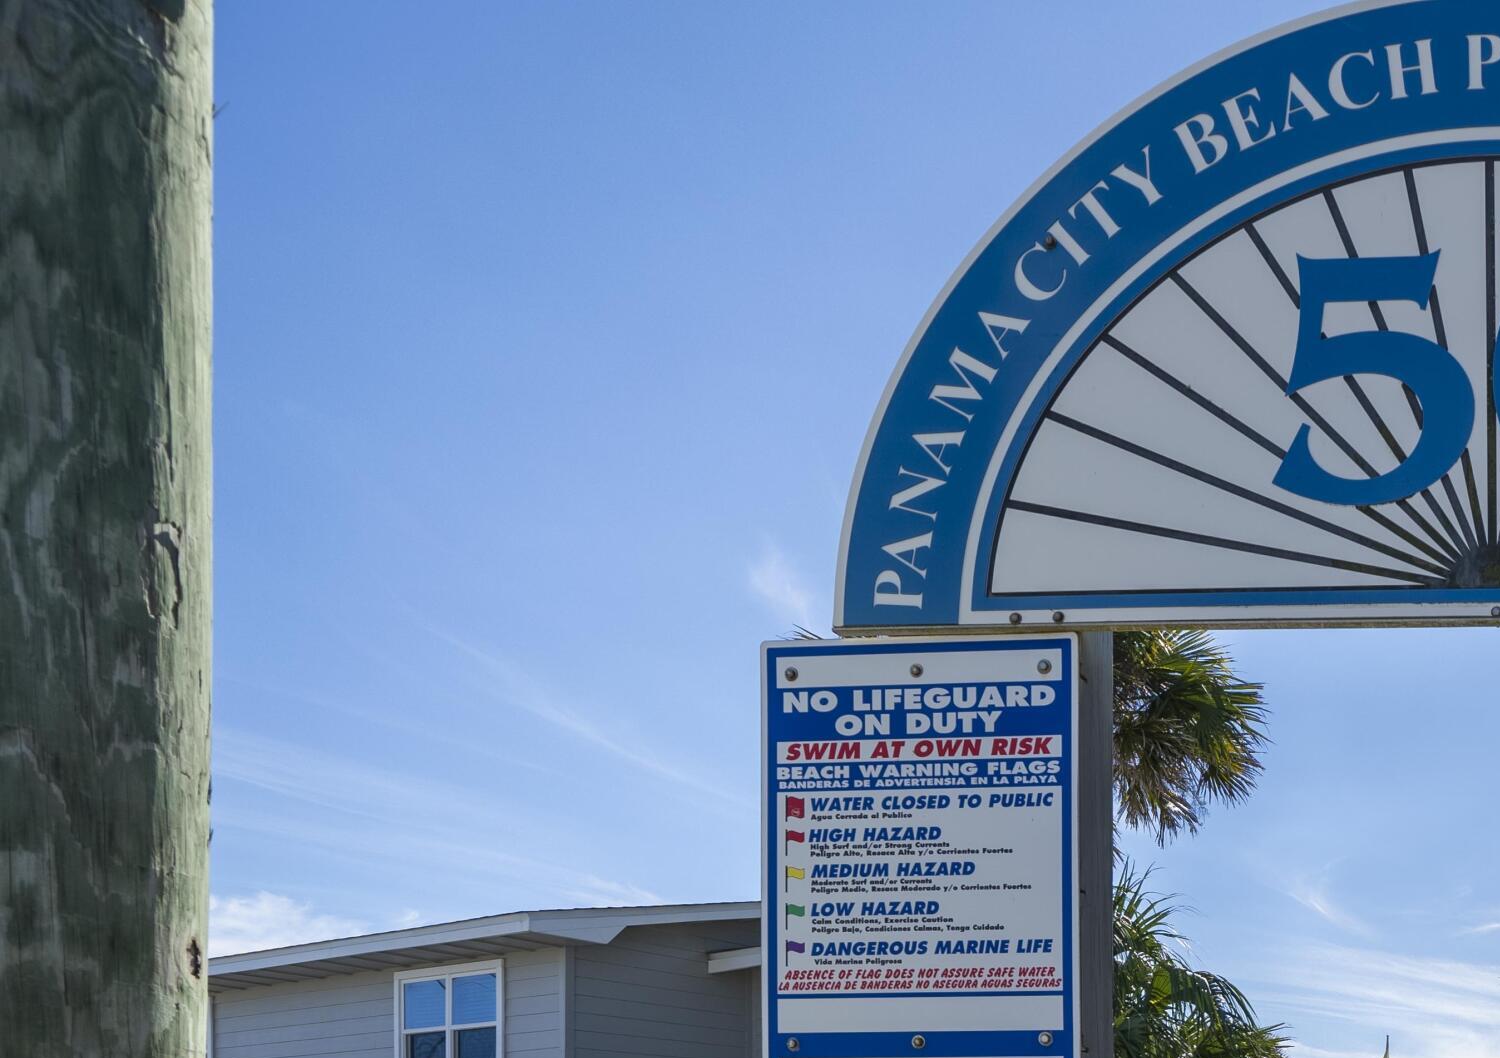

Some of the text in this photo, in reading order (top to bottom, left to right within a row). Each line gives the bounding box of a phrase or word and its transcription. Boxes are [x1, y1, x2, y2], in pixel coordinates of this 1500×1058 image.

[873, 310, 1031, 609] PANAMA
[1013, 145, 1164, 301] CITY
[1172, 39, 1439, 175] BEACH
[783, 684, 1055, 713] NO LIFEGUARD
[835, 710, 1002, 736] ON DUTY
[786, 737, 1052, 760] SWIM AT OWN RISK
[776, 760, 1060, 780] BEACH WARNING FLAGS
[778, 775, 1057, 789] BANDERAS DE ADVERTENSIA EN LA PLAYA
[811, 792, 1053, 811] WATER CLOSED TO PUBLIC
[808, 826, 941, 844] HIGH HAZARD
[810, 861, 975, 878] MEDIUM HAZARD
[810, 901, 939, 916] LOW HAZARD
[811, 938, 1053, 956] DANGEROUS MARINE LIFE
[865, 957, 902, 965] Peligrosa
[784, 966, 1055, 980] ABSENCE OF FLAG DOES NOT ASSURE SAFE WATER
